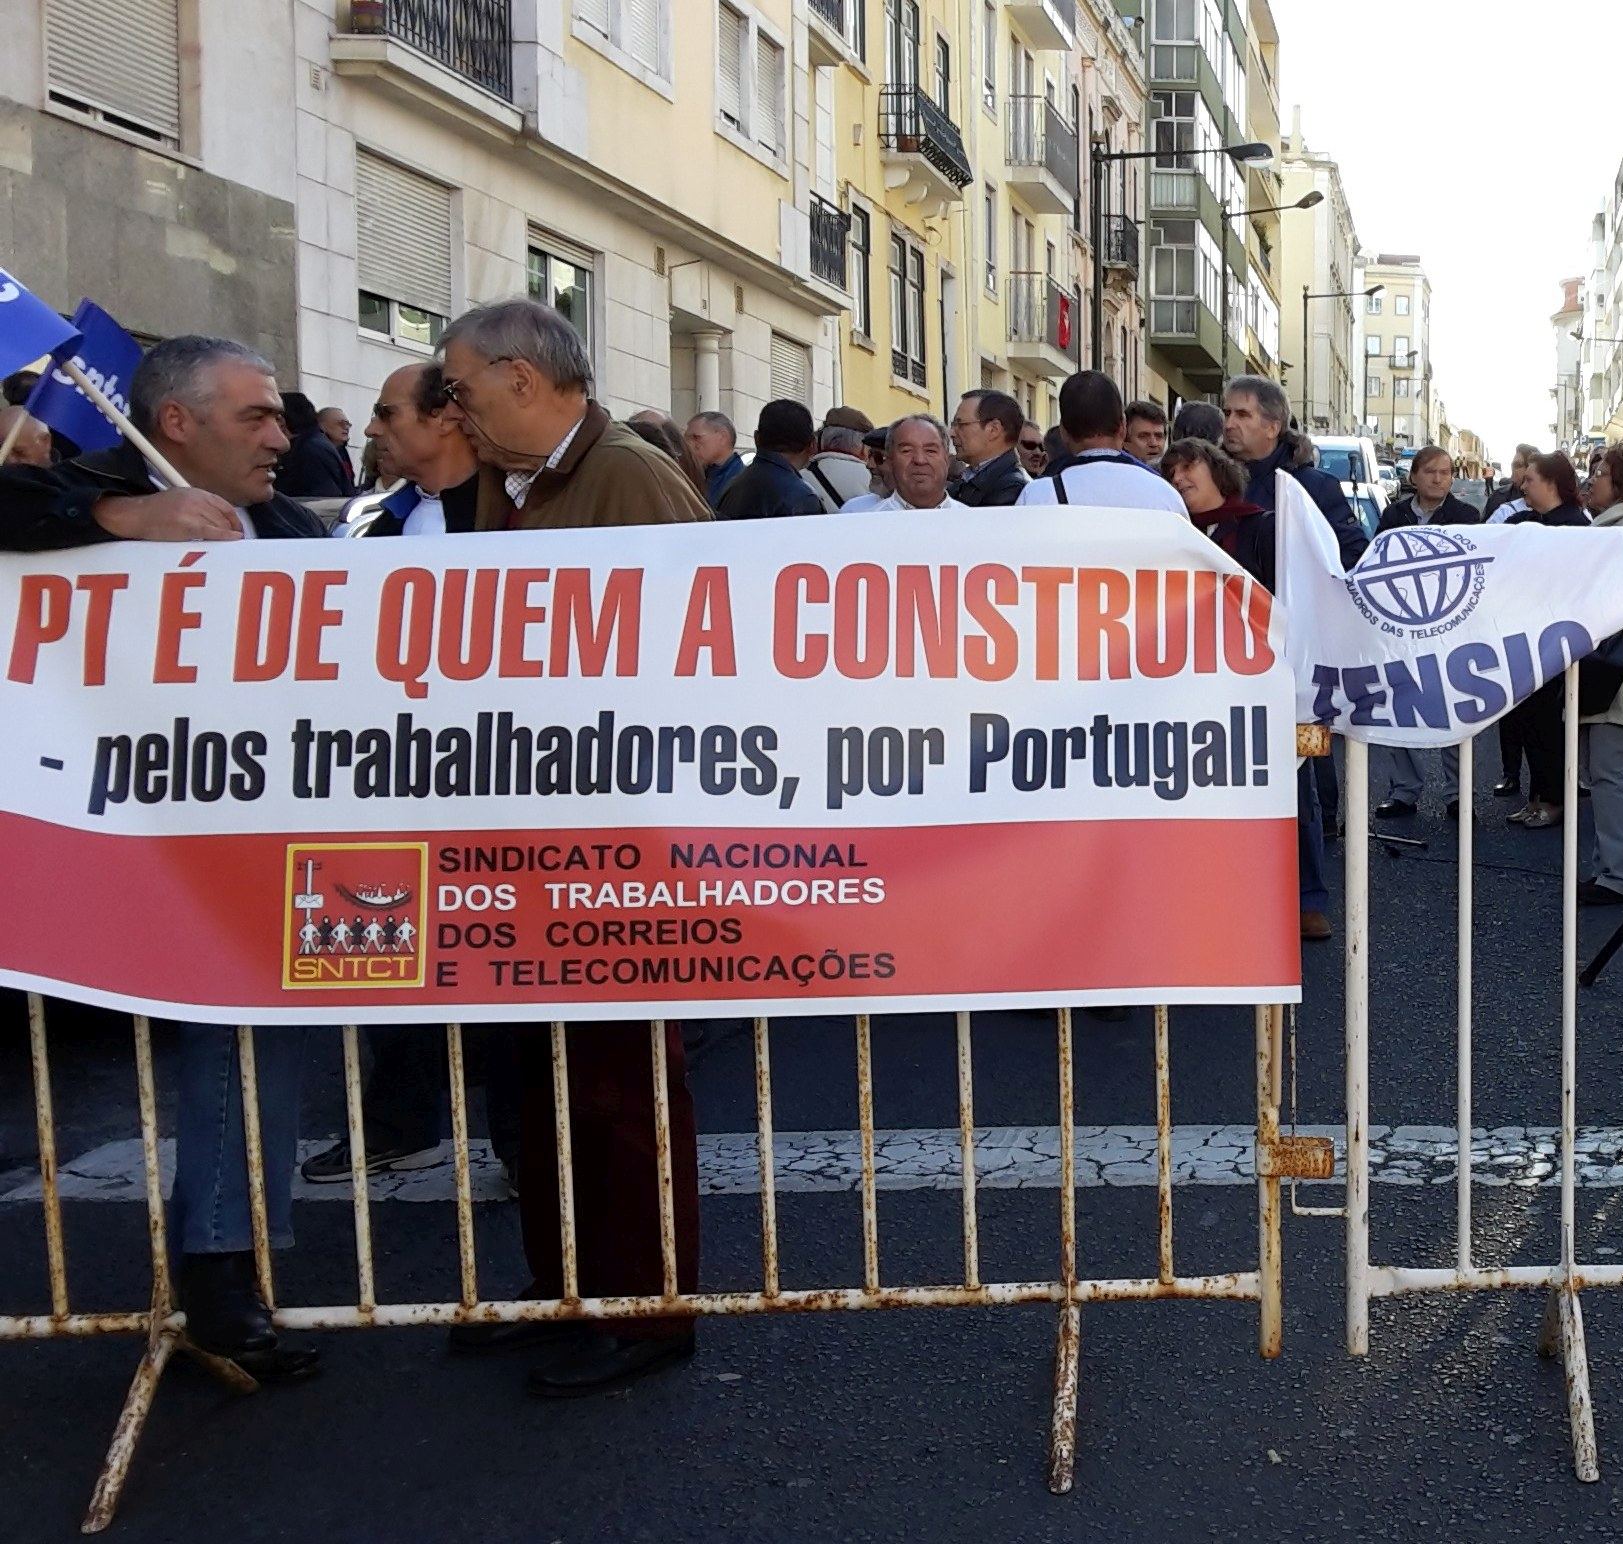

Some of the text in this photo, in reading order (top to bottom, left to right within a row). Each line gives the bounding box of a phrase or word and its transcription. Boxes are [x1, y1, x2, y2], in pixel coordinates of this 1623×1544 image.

[1453, 533, 1477, 551] DOS
[8, 551, 1276, 699] PT É DE QUEM A CONSTRUIU
[1380, 621, 1404, 638] DAS
[87, 716, 268, 816] pelos
[291, 711, 800, 810] trabalhadores,
[826, 724, 945, 810] por
[969, 705, 1269, 801] Portugal!
[438, 842, 868, 872] SINDICATO NACIONAL
[437, 877, 886, 911] DOS TRABALHADORES
[437, 918, 742, 948] DOS CORREIOS
[294, 957, 415, 979] SNTCT
[436, 949, 896, 987] E TELECOMUNICAÇÕES
